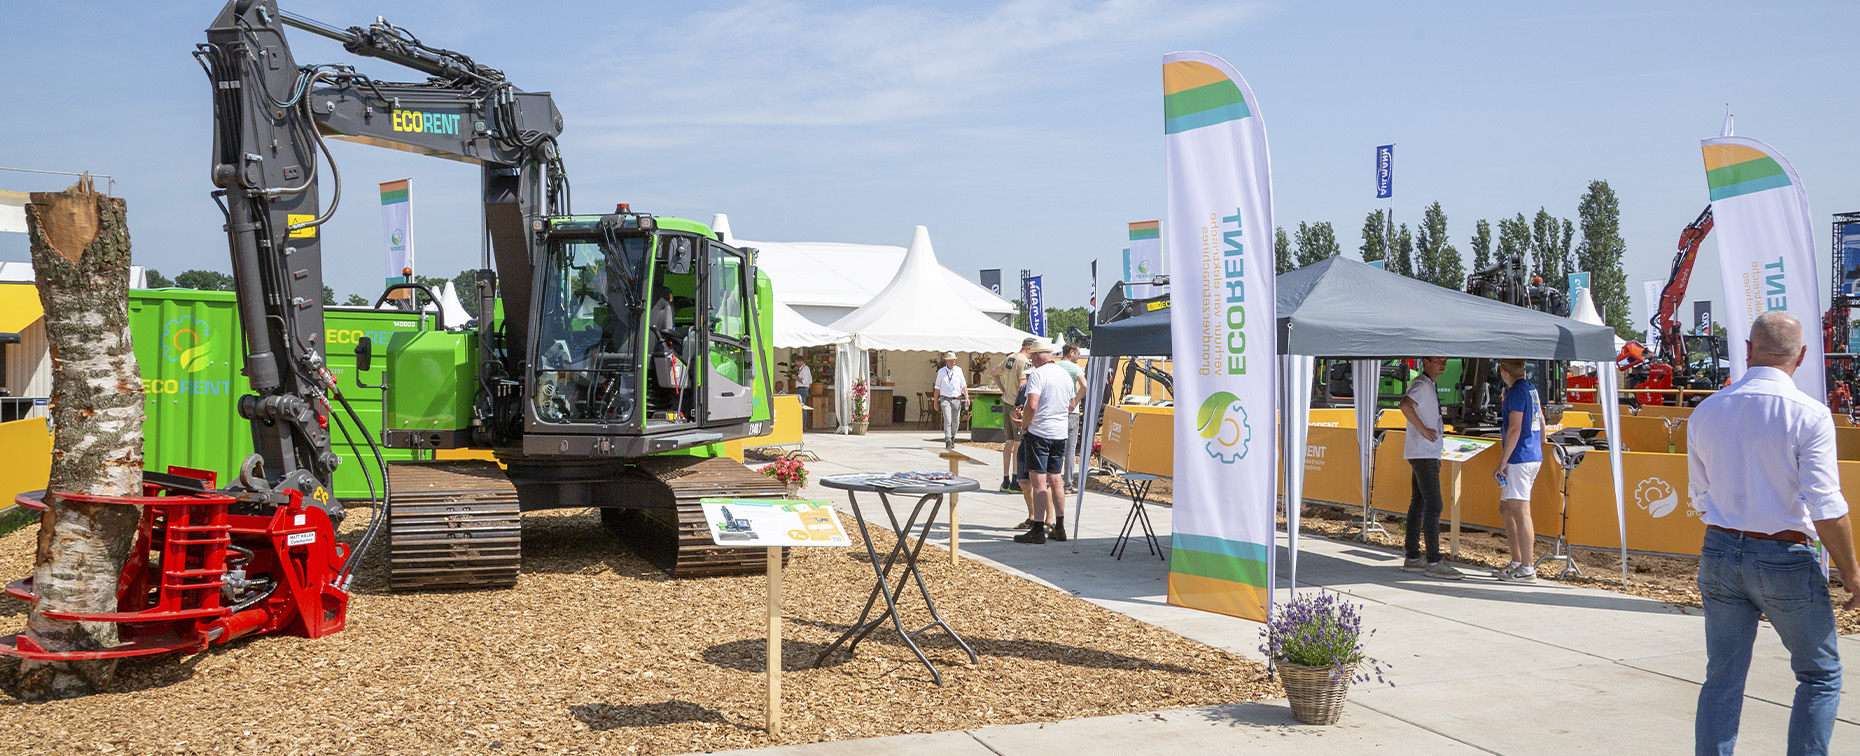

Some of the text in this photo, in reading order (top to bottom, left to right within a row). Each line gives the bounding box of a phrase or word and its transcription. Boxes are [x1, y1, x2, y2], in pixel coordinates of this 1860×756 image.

[392, 109, 461, 135] ECORENT
[325, 328, 396, 346] ECORE
[140, 378, 233, 395] ECORENT
